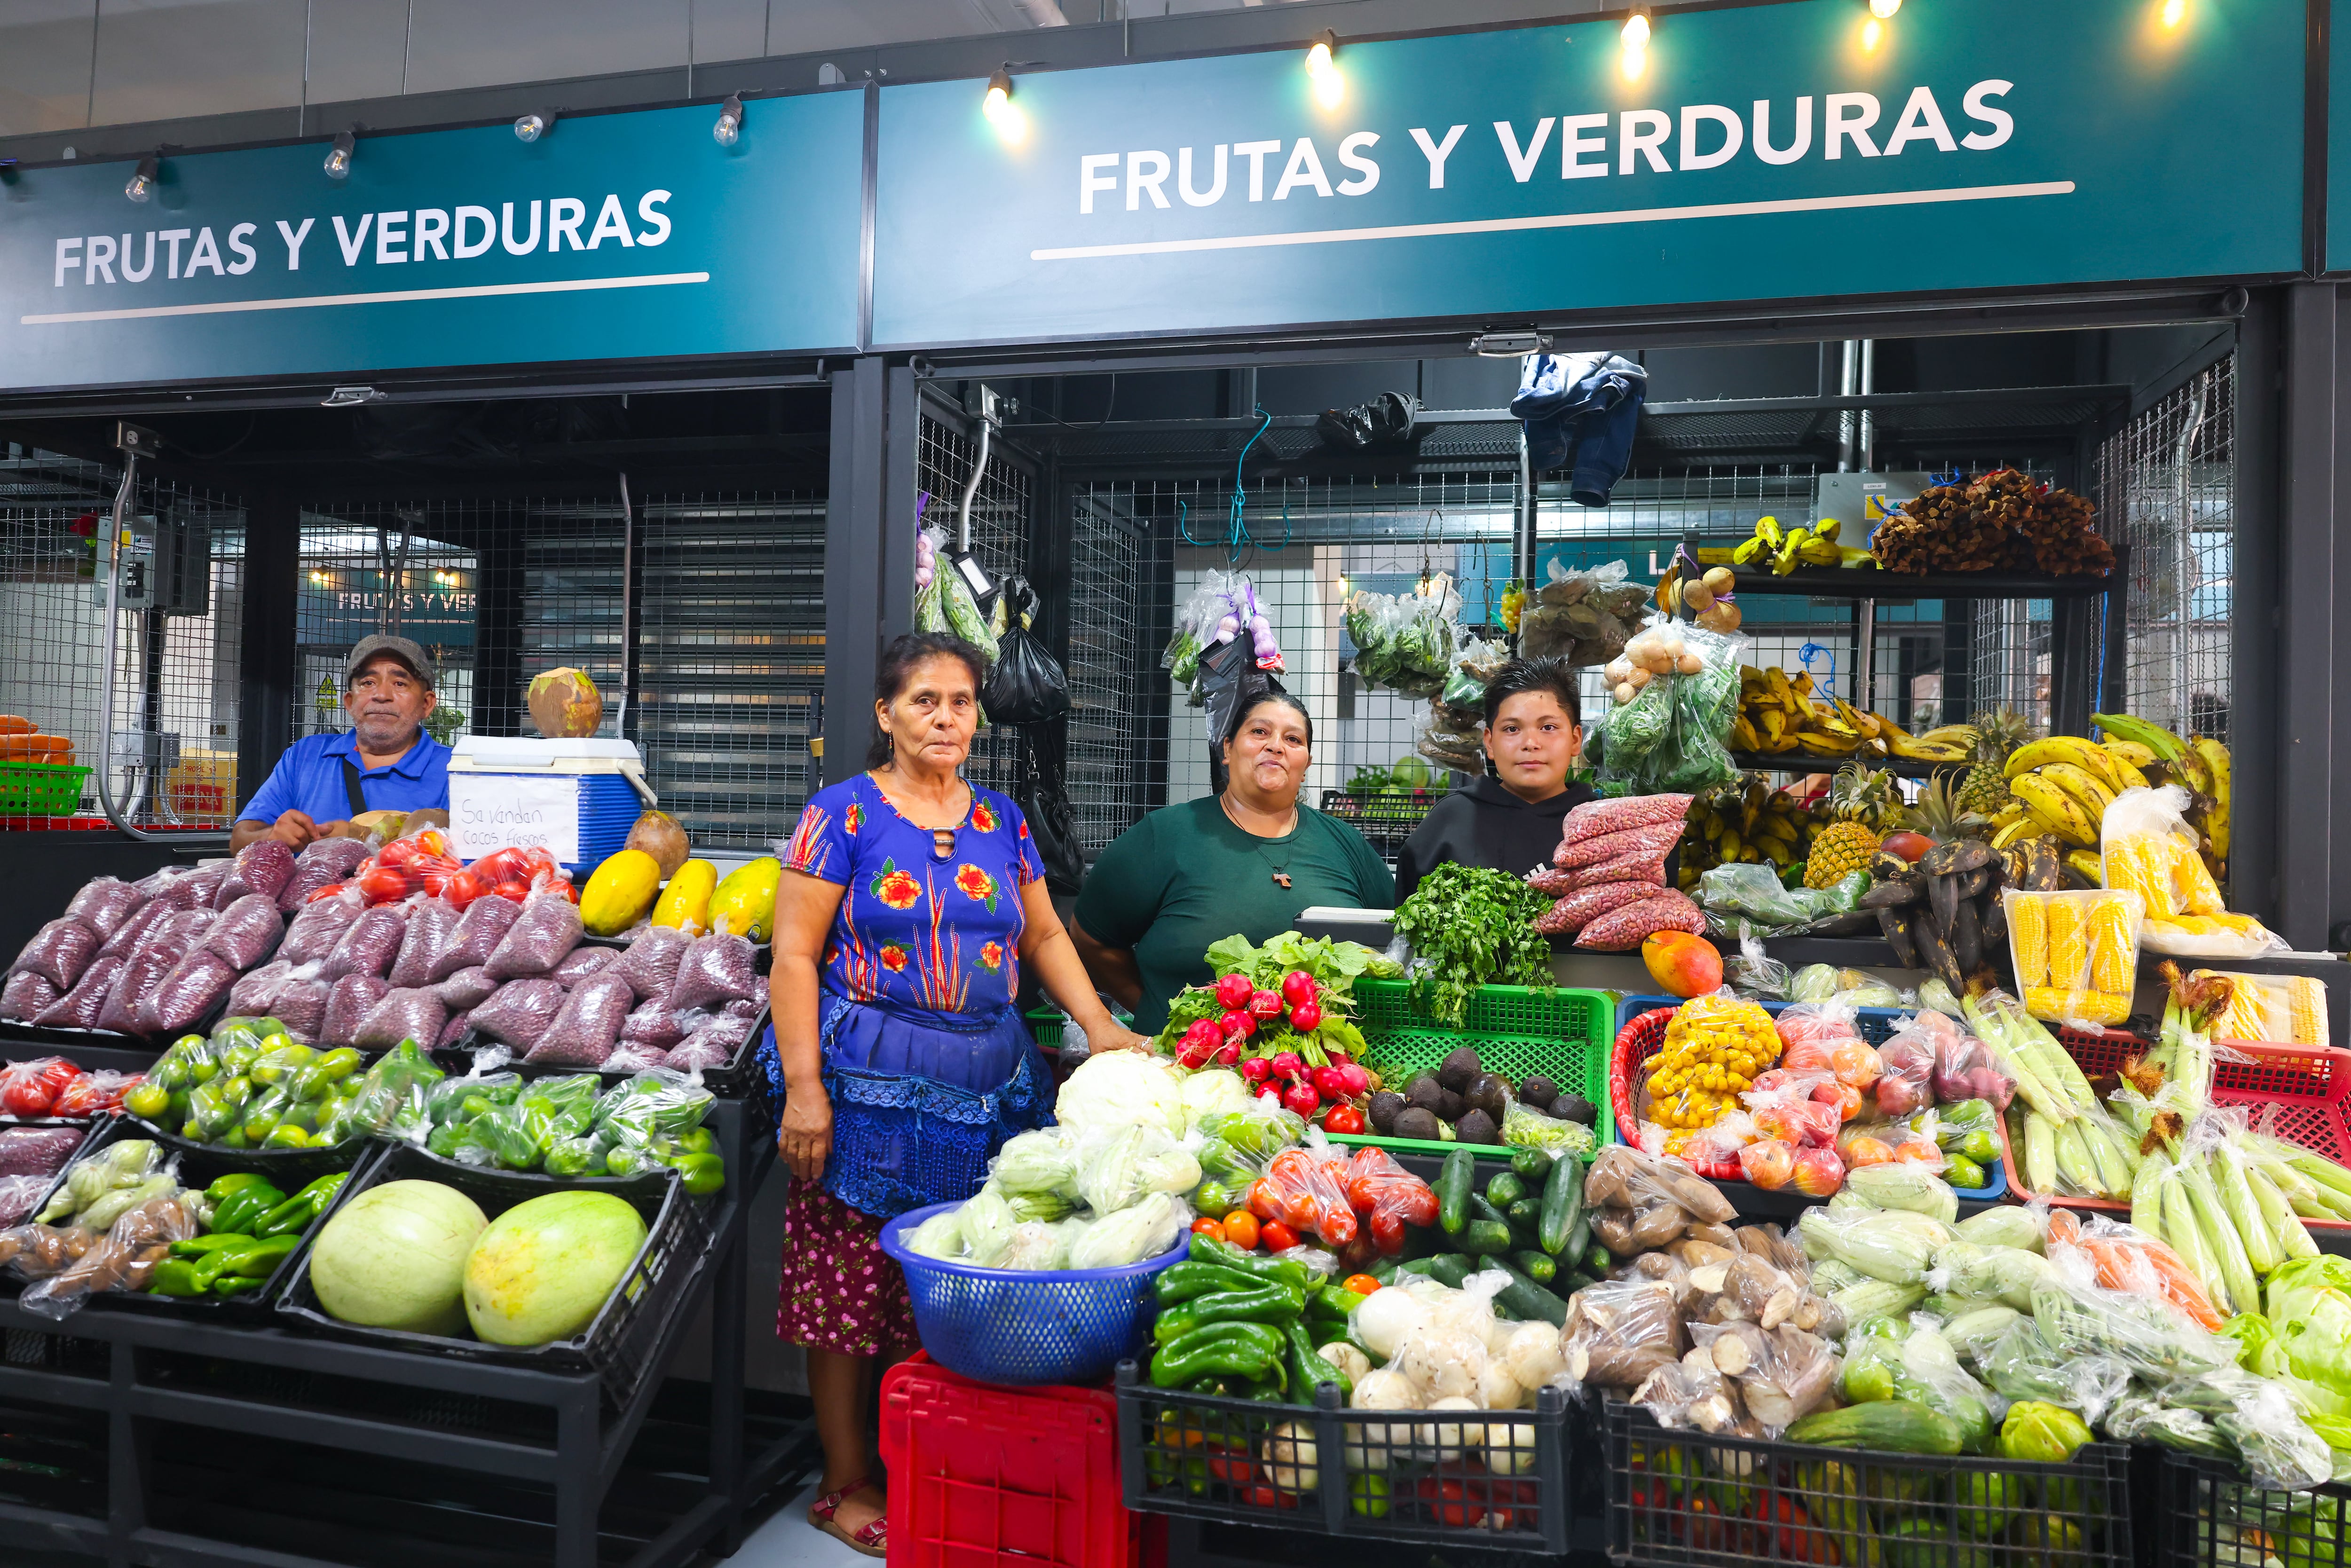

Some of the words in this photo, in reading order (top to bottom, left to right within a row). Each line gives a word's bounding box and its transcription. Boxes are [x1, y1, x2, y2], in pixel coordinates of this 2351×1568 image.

[1079, 131, 1381, 214] FRUTAS
[1409, 125, 1468, 189] Y
[1493, 79, 2013, 182] VERDURAS
[55, 223, 256, 287] FRUTAS
[276, 219, 315, 270] Y
[332, 190, 671, 266] VERDURAS
[420, 593, 435, 611] Y
